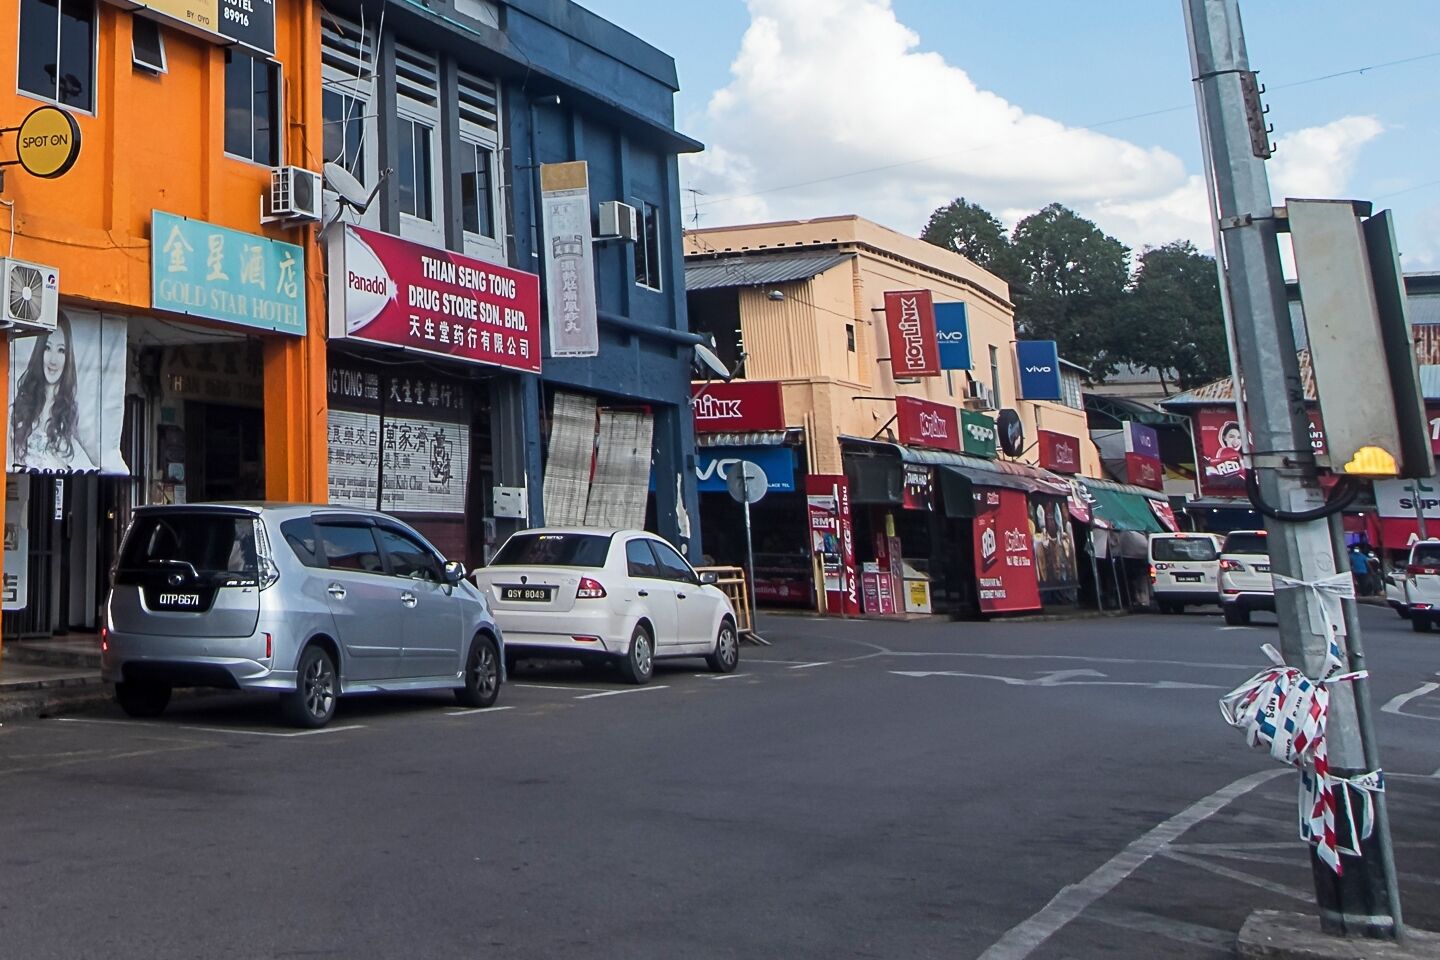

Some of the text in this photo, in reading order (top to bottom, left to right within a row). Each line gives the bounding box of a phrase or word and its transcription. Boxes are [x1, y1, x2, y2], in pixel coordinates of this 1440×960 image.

[198, 14, 210, 25] OYO
[223, 6, 250, 27] 89916
[22, 133, 68, 149] SPOT ON
[162, 223, 298, 300] 金星酒店
[348, 270, 387, 296] Panadol
[421, 255, 516, 299] THIAN SENG TONG
[161, 278, 302, 327] GOLD STAR HOTEL
[408, 284, 528, 332] DRUG STORE SDN. BHD.
[409, 314, 529, 359] 天生堂药行有限公司
[1025, 365, 1051, 373] vivo
[338, 369, 363, 397] TONG
[159, 593, 199, 606] QTP6671
[507, 590, 545, 599] QSY 8049
